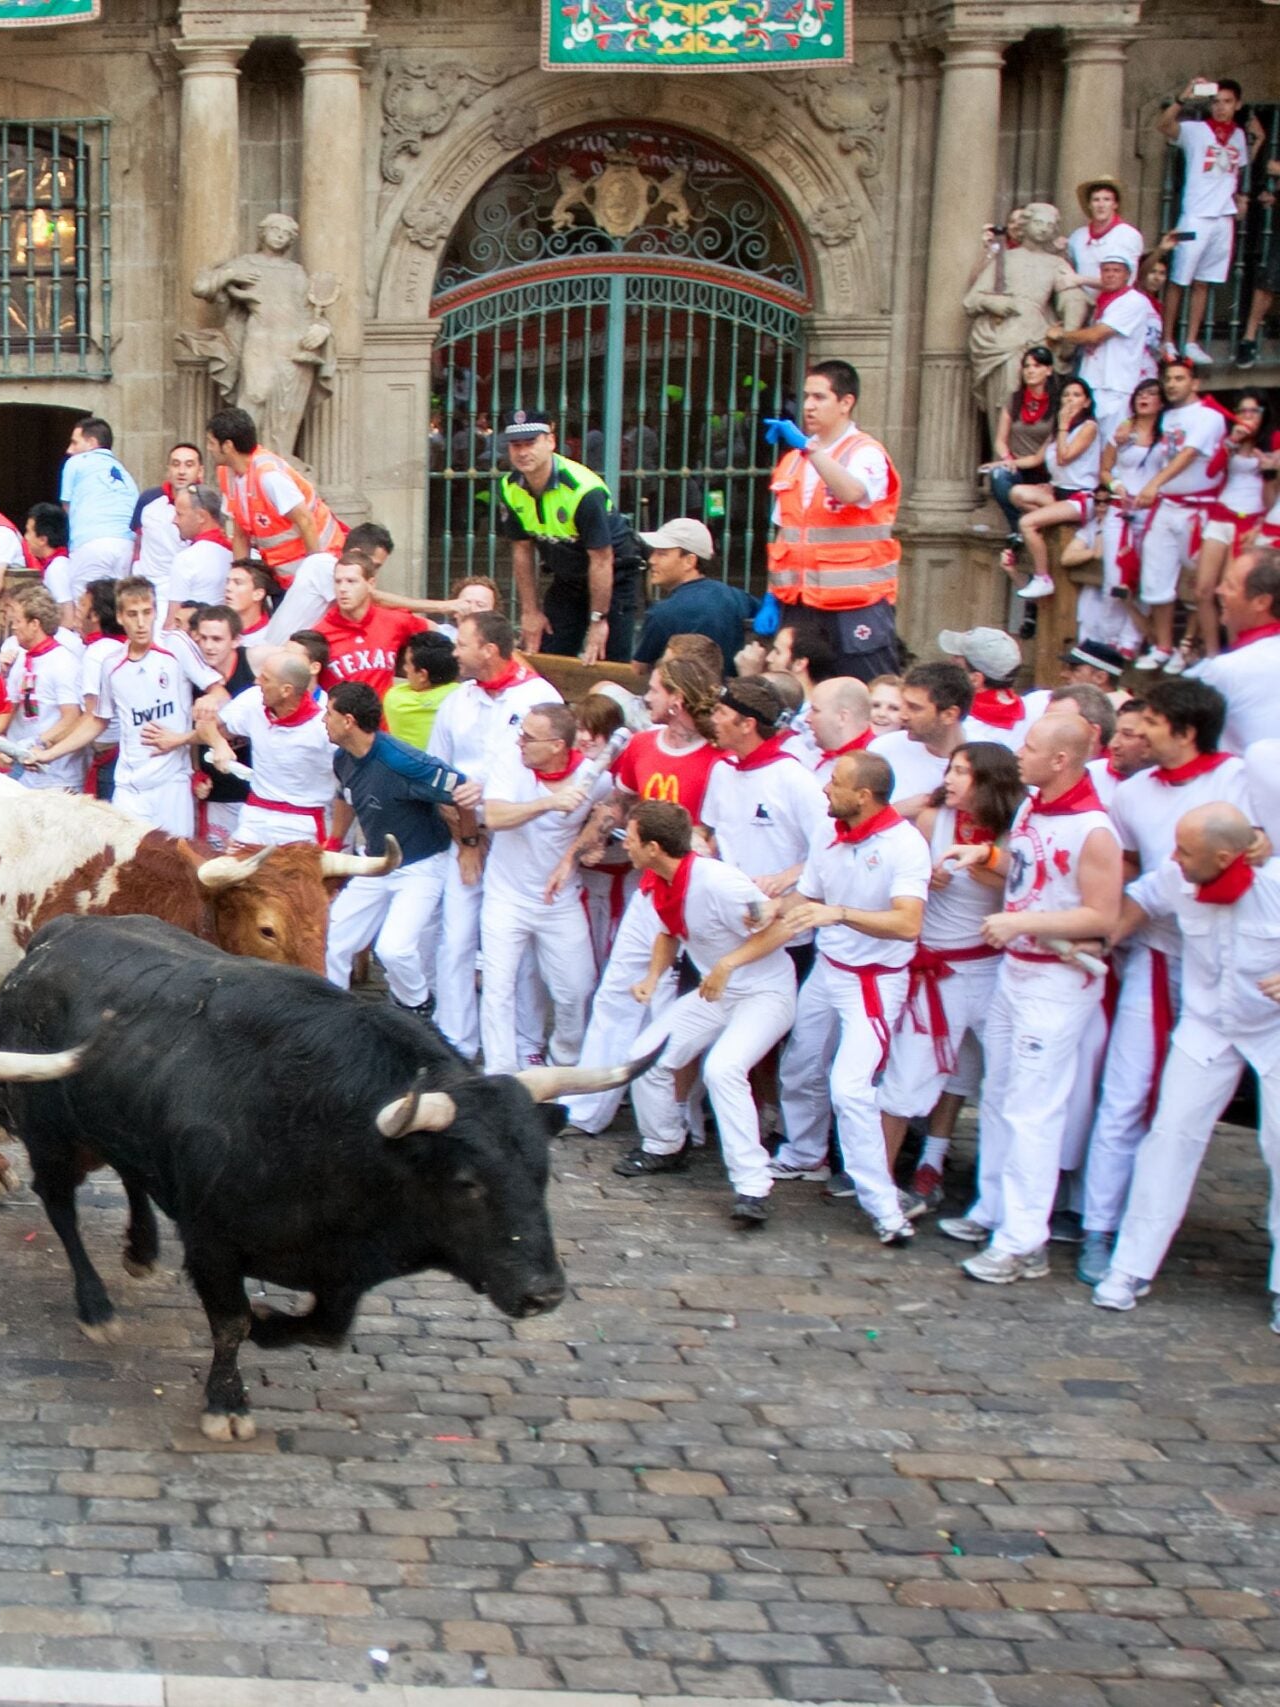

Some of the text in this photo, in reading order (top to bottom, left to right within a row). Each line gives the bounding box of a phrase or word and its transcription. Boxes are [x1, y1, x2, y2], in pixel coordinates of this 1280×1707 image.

[443, 145, 499, 202] OMNIBUS
[329, 649, 397, 679] TEXAS
[131, 700, 175, 727] bwin
